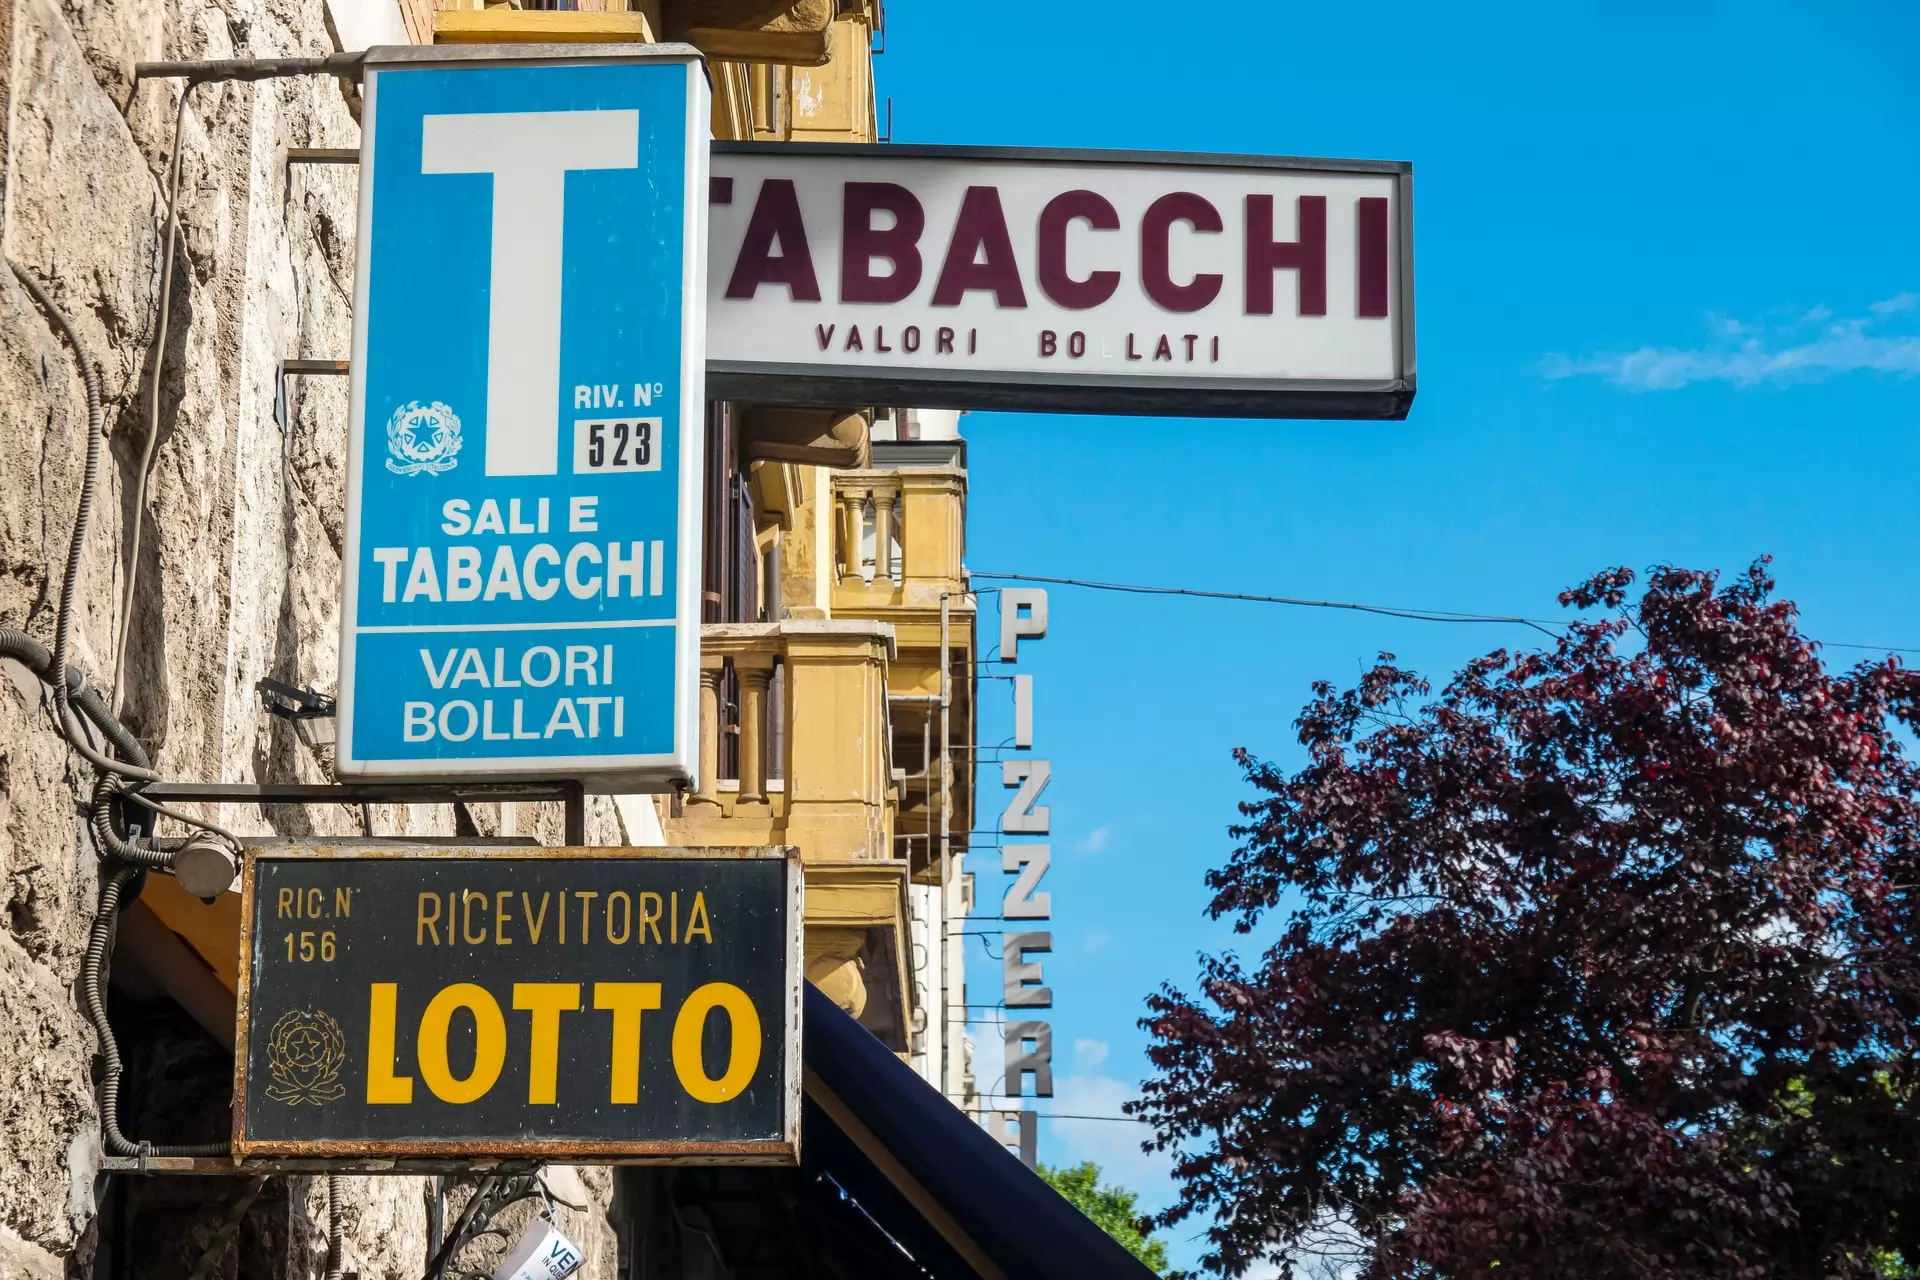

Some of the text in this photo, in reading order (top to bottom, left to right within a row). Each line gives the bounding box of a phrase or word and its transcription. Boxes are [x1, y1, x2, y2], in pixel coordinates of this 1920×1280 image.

[708, 177, 1388, 319] ABACCHI
[422, 109, 639, 476] T
[816, 323, 977, 354] VALORI
[575, 384, 624, 409] RIV.
[589, 423, 651, 467] 523
[441, 496, 598, 536] SALI E
[373, 540, 664, 603] TABACCHI
[419, 644, 613, 690] VALORI
[403, 696, 624, 743] BOLLATI
[416, 890, 713, 946] RICEVITORIA
[284, 931, 336, 963] 156
[366, 982, 762, 1105] LOTTO
